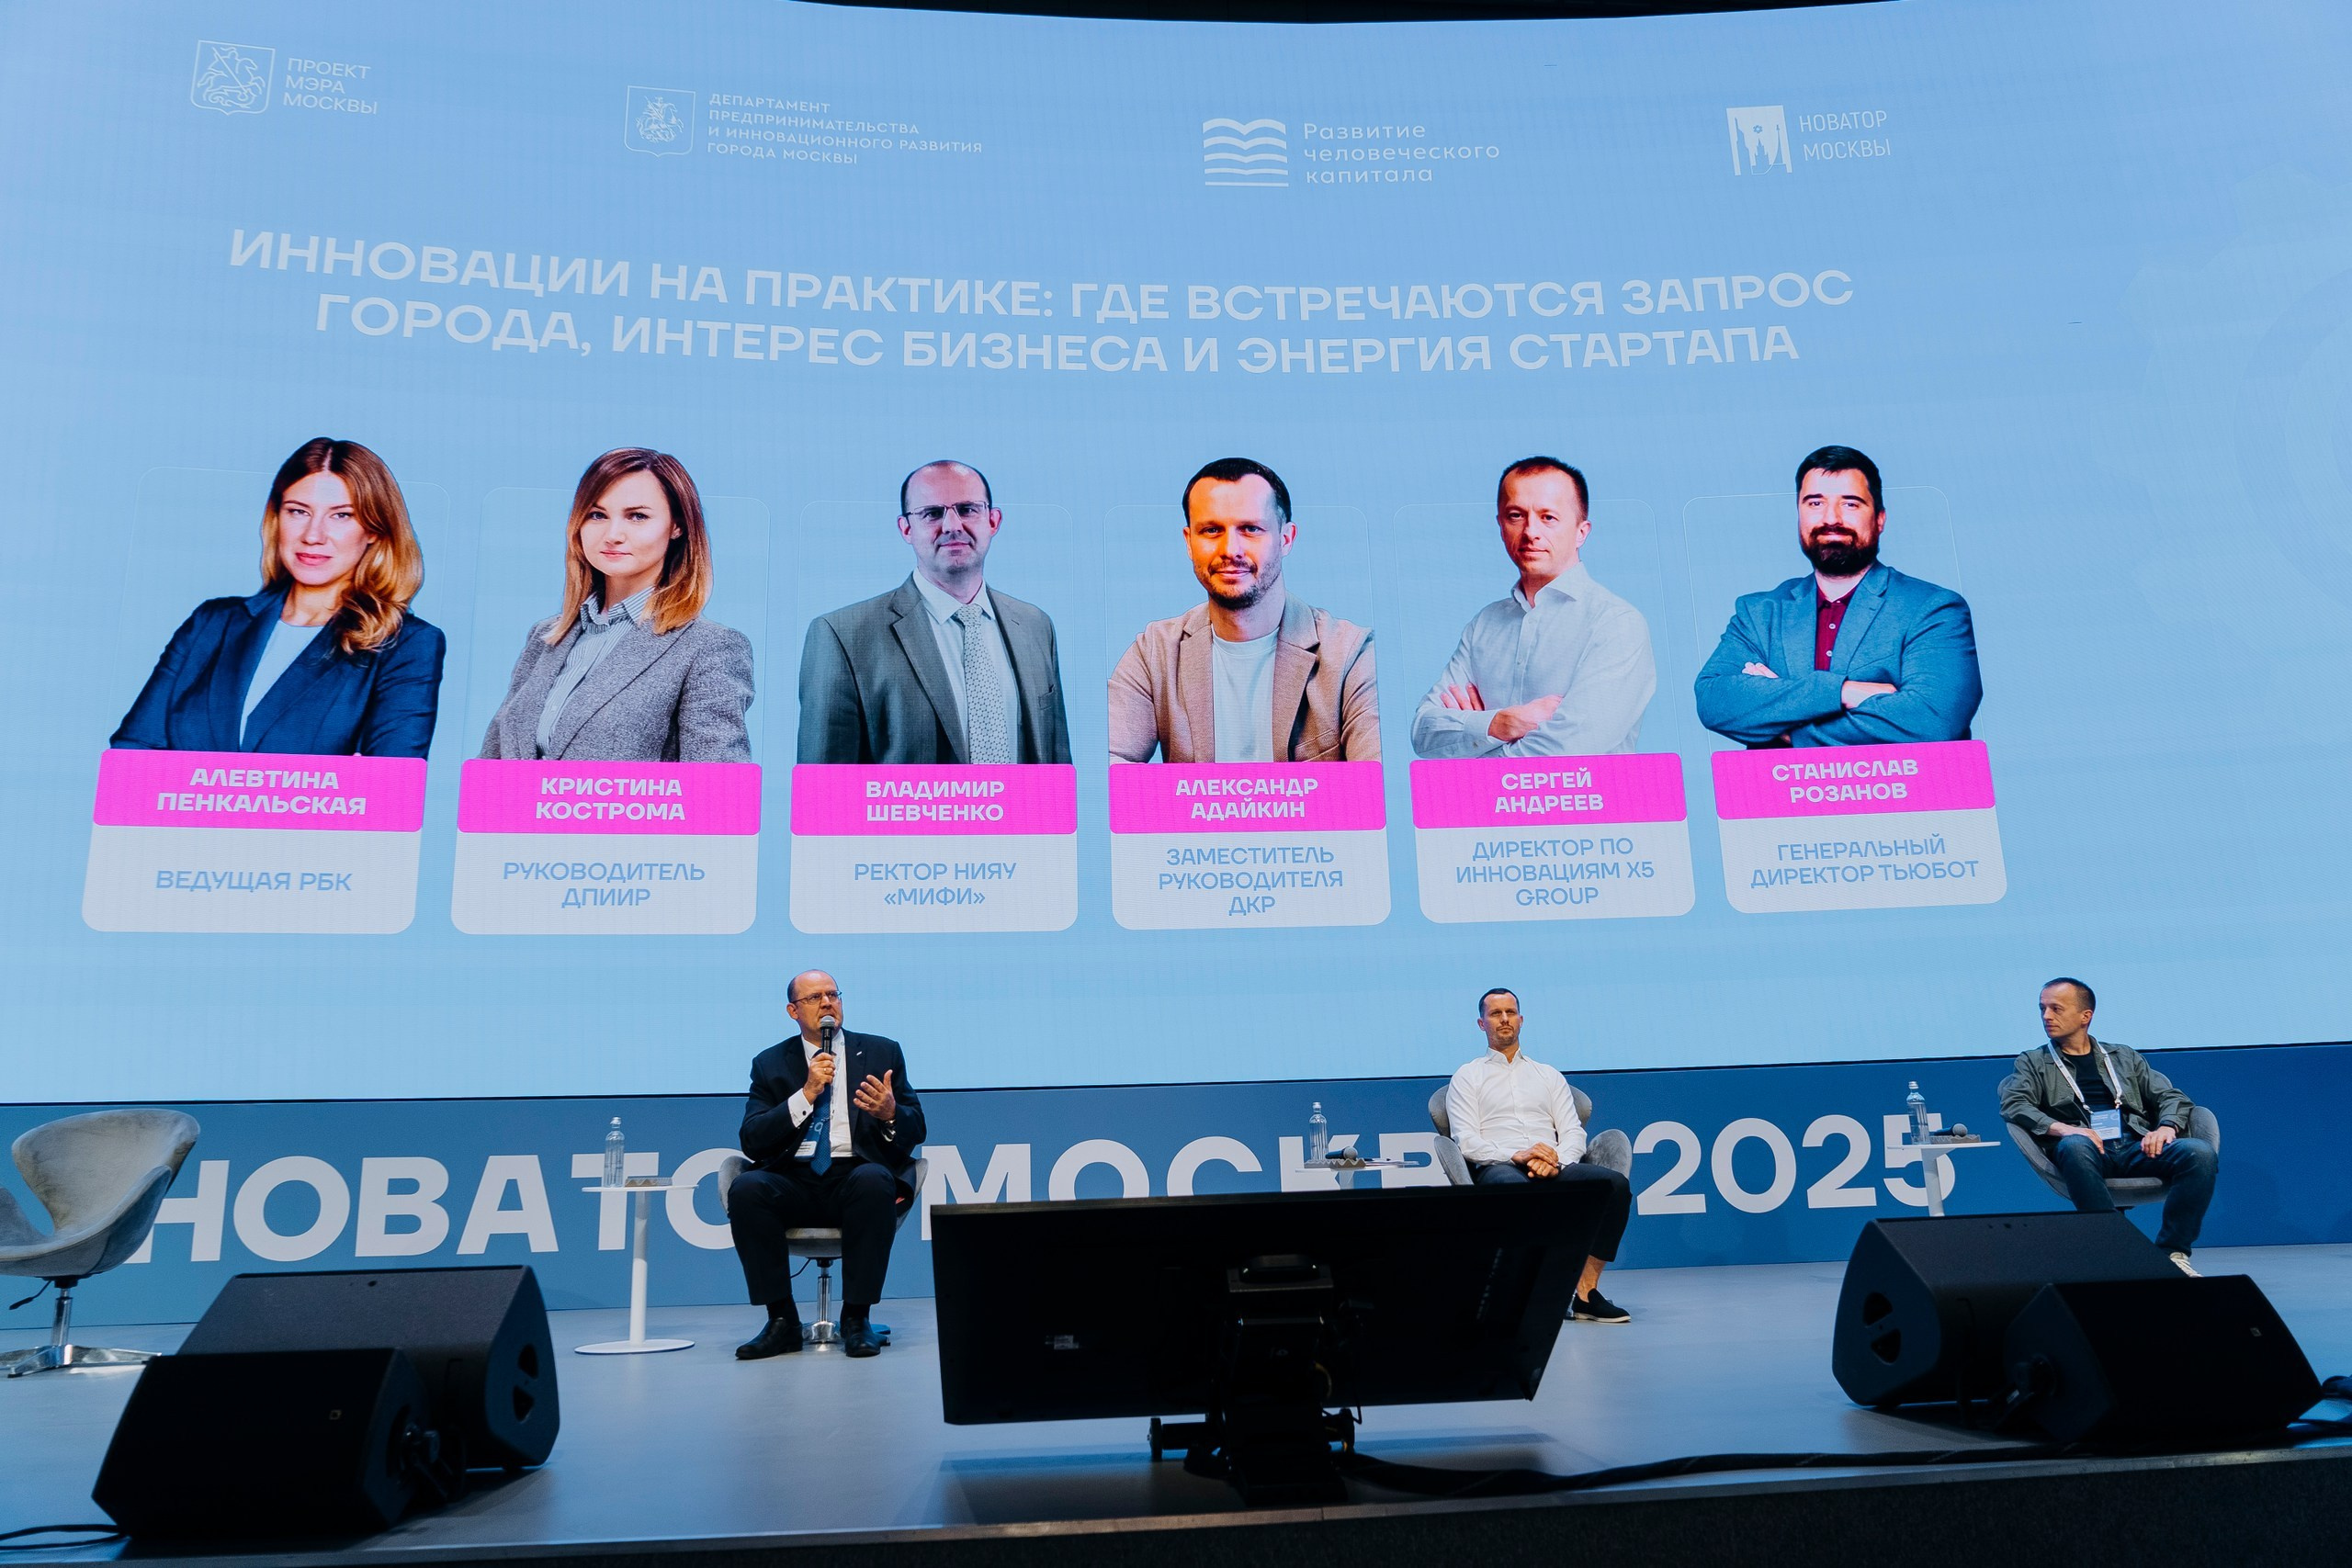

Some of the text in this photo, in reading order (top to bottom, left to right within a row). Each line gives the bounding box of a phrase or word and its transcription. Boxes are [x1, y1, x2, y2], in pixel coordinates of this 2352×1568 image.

[287, 57, 371, 80] ПРОЕКТ
[285, 73, 345, 95] МЭРА
[283, 91, 378, 115] МОСКВЫ
[708, 93, 831, 114] ДЕПАРТАМЕНТ
[708, 108, 920, 134] ПРЕДПРИНИМАТЕЛЬСТВА
[1304, 122, 1426, 141] Развитие
[1799, 109, 1887, 132] НОВАТОР
[707, 126, 982, 153] И ИННОВАЦИОННОГО РАЗВИТИЯ
[1803, 138, 1892, 162] МОСКВЫ
[707, 141, 857, 164] ГОРОДА МОСКВЫ
[1304, 145, 1500, 162] человеческого
[1306, 168, 1432, 185] капитала
[230, 229, 1853, 324] ИННОВАЦИИ НА ПРАКТИКЕ: ГДЕ ВСТРЕЧАЮТСЯ ЗАПРОС
[316, 293, 1800, 374] ГОРОДА, ИНТЕРЕС БИЗНЕСА И ЭНЕРГИЯ СТАРТАПА
[189, 768, 339, 790] АЛЕВТИНА
[1501, 766, 1592, 791] СЕРГЕЙ
[1771, 759, 1919, 782] СТАНИСЛАВ
[541, 777, 683, 796] КРИСТИНА
[865, 781, 1005, 801] ВЛАДИМИР
[1175, 778, 1318, 797] АЛЕКСАНДР
[1790, 782, 1908, 804] РОЗАНОВ
[157, 792, 367, 816] ПЕНКАЛЬСКАЯ
[536, 801, 685, 820] КОСТРОМА
[866, 804, 1004, 822] ШЕВЧЕНКО
[1191, 796, 1306, 822] АДАЙКИН
[1495, 794, 1604, 815] АНДРЕЕВ
[1166, 846, 1335, 866] ЗАМЕСТИТЕЛЬ
[1472, 837, 1634, 862] ДИРЕКТОР ПО
[1777, 832, 1946, 862] ГЕНЕРАЛЬНЫЙ
[155, 870, 353, 893] ВЕДУЩАЯ РБК
[503, 862, 706, 884] РУКОВОДИТЕЛЬ
[854, 862, 1017, 881] РЕКТОР НИЯУ
[1159, 870, 1343, 892] РУКОВОДИТЕЛЯ
[1455, 862, 1621, 884] ИННОВАЦИЯМ
[1750, 860, 1979, 889] ДИРЕКТОР ТЬЮБОТ
[560, 887, 651, 909] ДПИИР
[884, 886, 986, 907] «МИФИ»
[1227, 895, 1276, 917] ДКР
[1515, 886, 1600, 907] GROUP
[122, 1148, 757, 1264] НОВАТО
[1633, 1112, 1956, 1215] 2025
